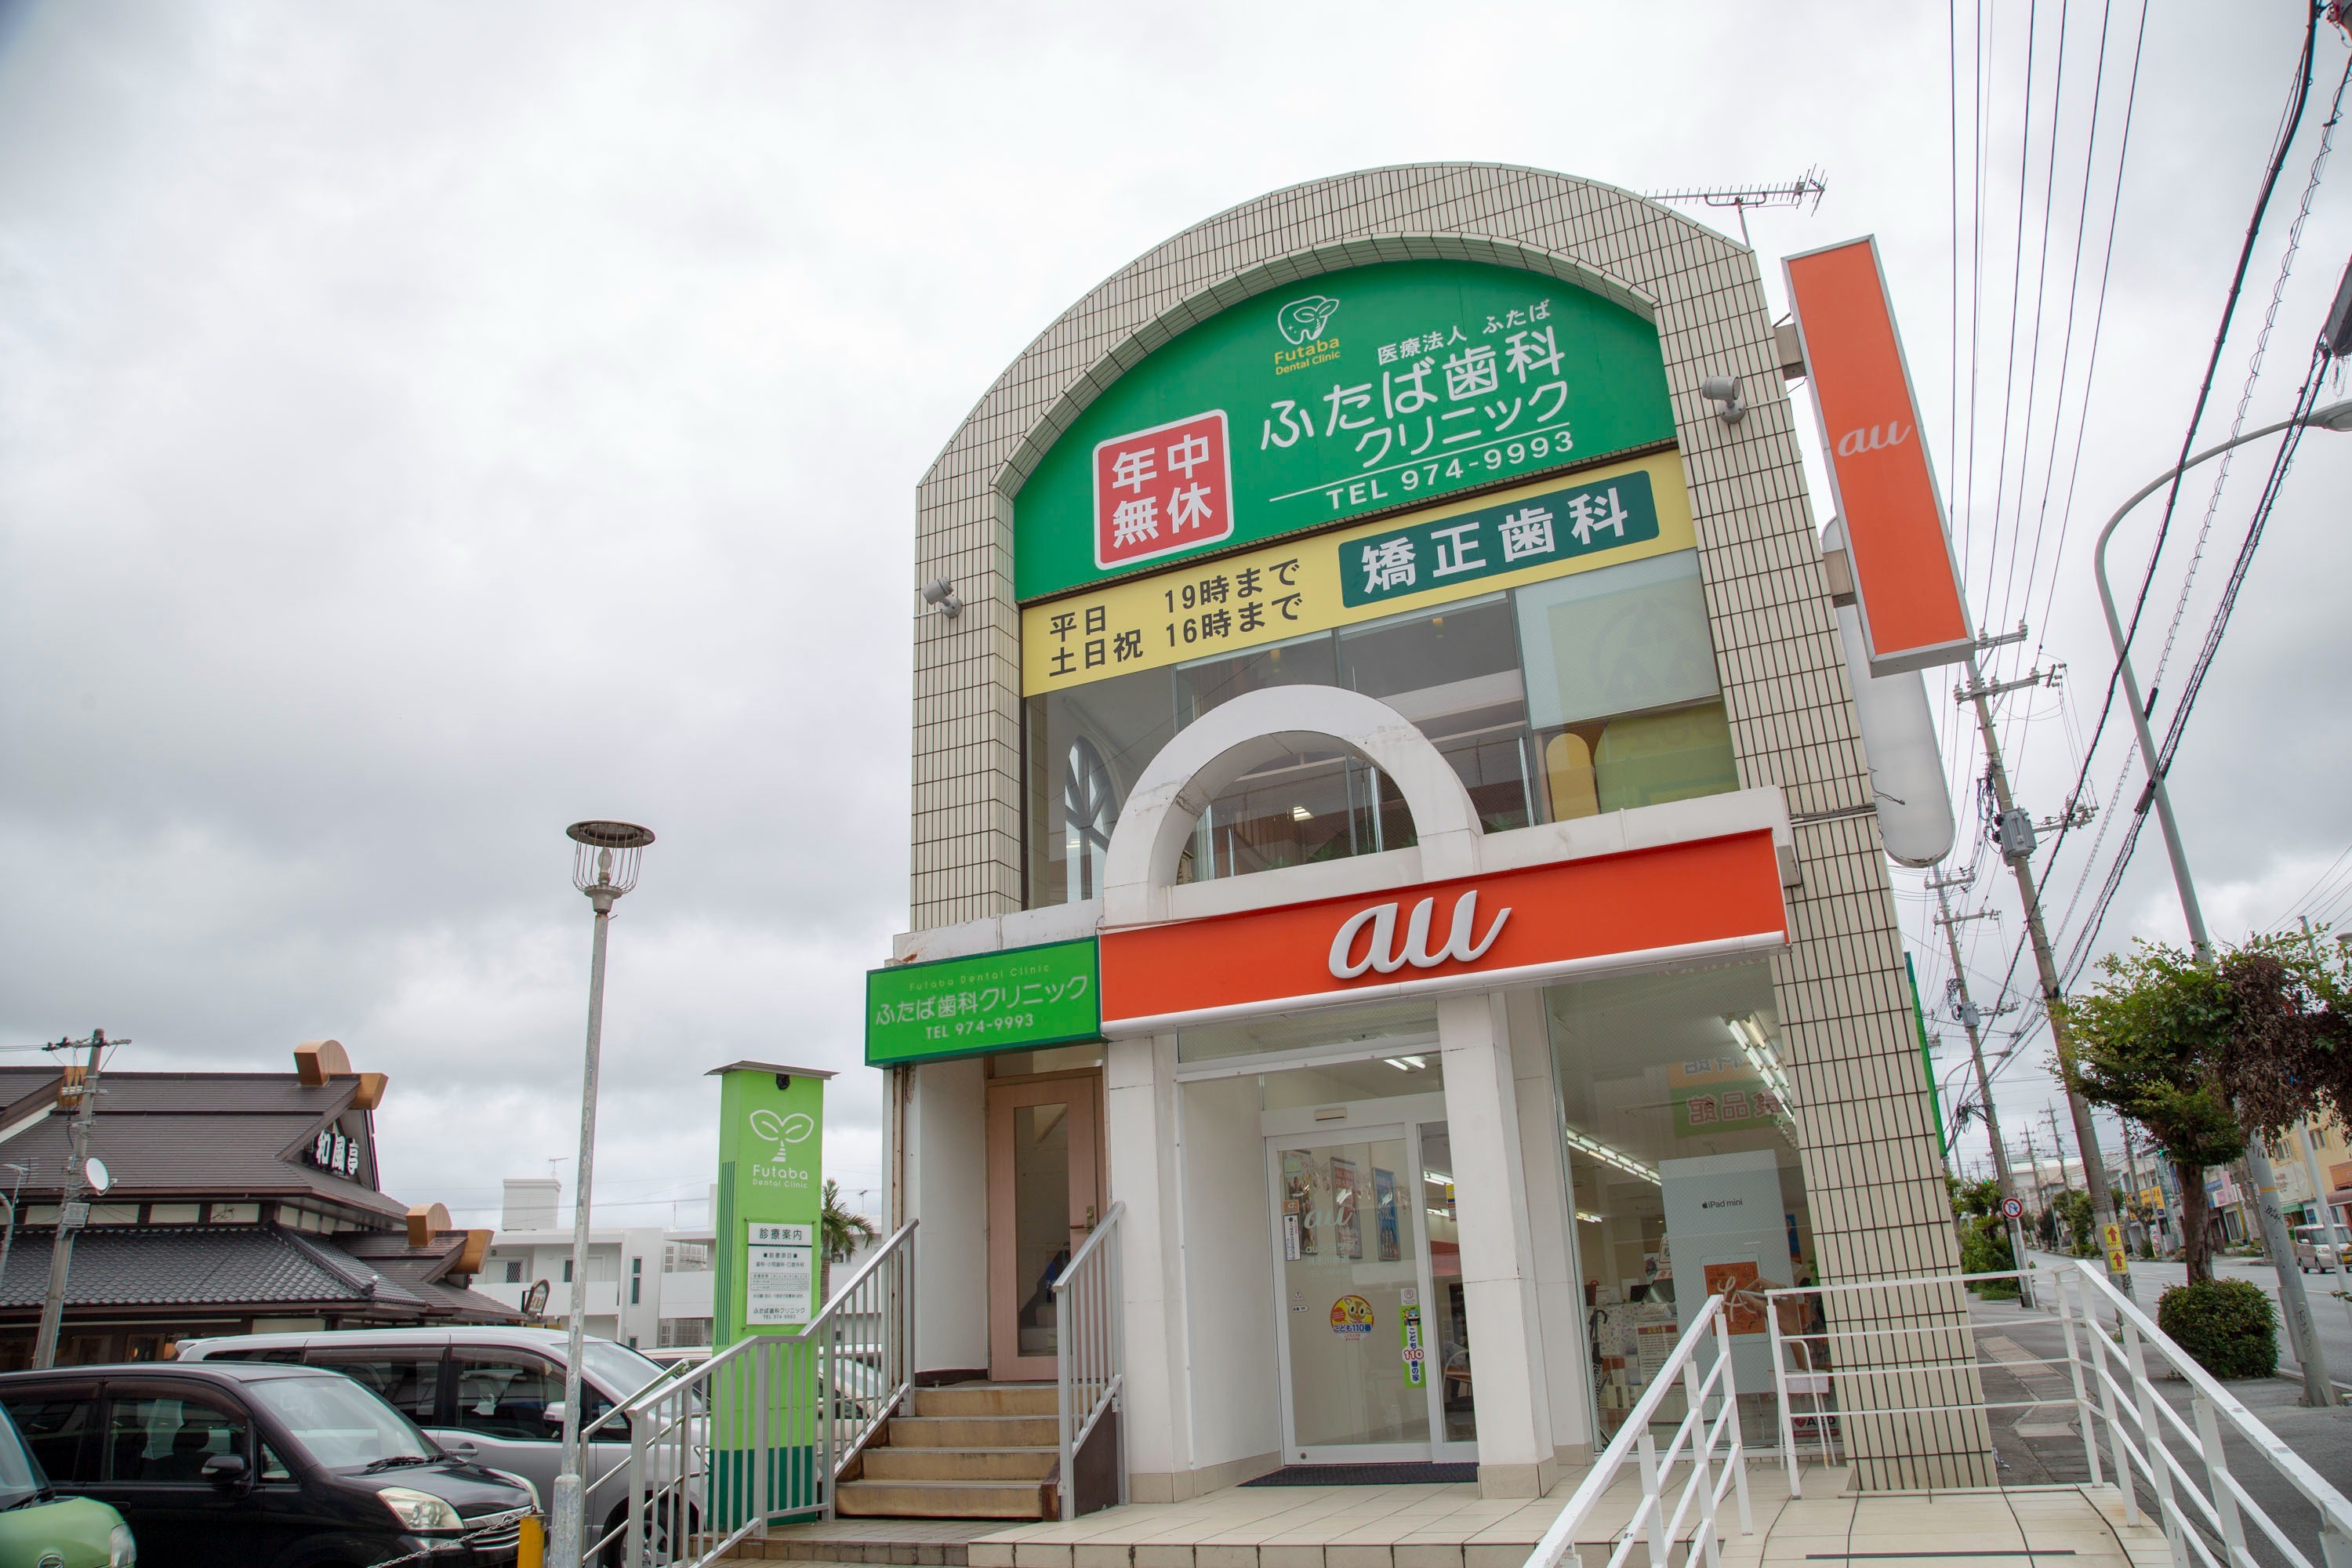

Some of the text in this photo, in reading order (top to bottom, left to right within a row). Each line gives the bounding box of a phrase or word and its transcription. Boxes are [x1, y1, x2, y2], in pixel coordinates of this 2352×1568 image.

[1274, 337, 1340, 365] Futaba
[1377, 299, 1551, 365] 医療法人 ふたば
[1275, 350, 1341, 376] Dental Clinic
[1261, 325, 1566, 450] ふたば歯科
[1355, 380, 1568, 468] クリニック
[1837, 420, 1912, 457] au
[1112, 434, 1210, 494] 年中
[1326, 431, 1574, 510] TEL 974-9993
[1112, 482, 1213, 549] 無休
[1361, 487, 1628, 594] 矯正歯科
[1049, 558, 1301, 643] 平日 19時まで
[1048, 592, 1303, 677] 土日祝 16時まで
[1328, 889, 1512, 980] au
[909, 964, 1050, 991] Futaba Dental Clinic
[876, 975, 1088, 1025] ふたば歯科クリニック
[926, 1013, 1034, 1040] TEL 974-9993
[753, 1164, 808, 1180] Futaba
[753, 1178, 808, 1189] Dental Clinic
[1304, 1206, 1354, 1229] au
[1708, 1198, 1743, 1209] iPad mini
[759, 1228, 802, 1240] 診療案内
[1333, 1323, 1372, 1332] こども110番
